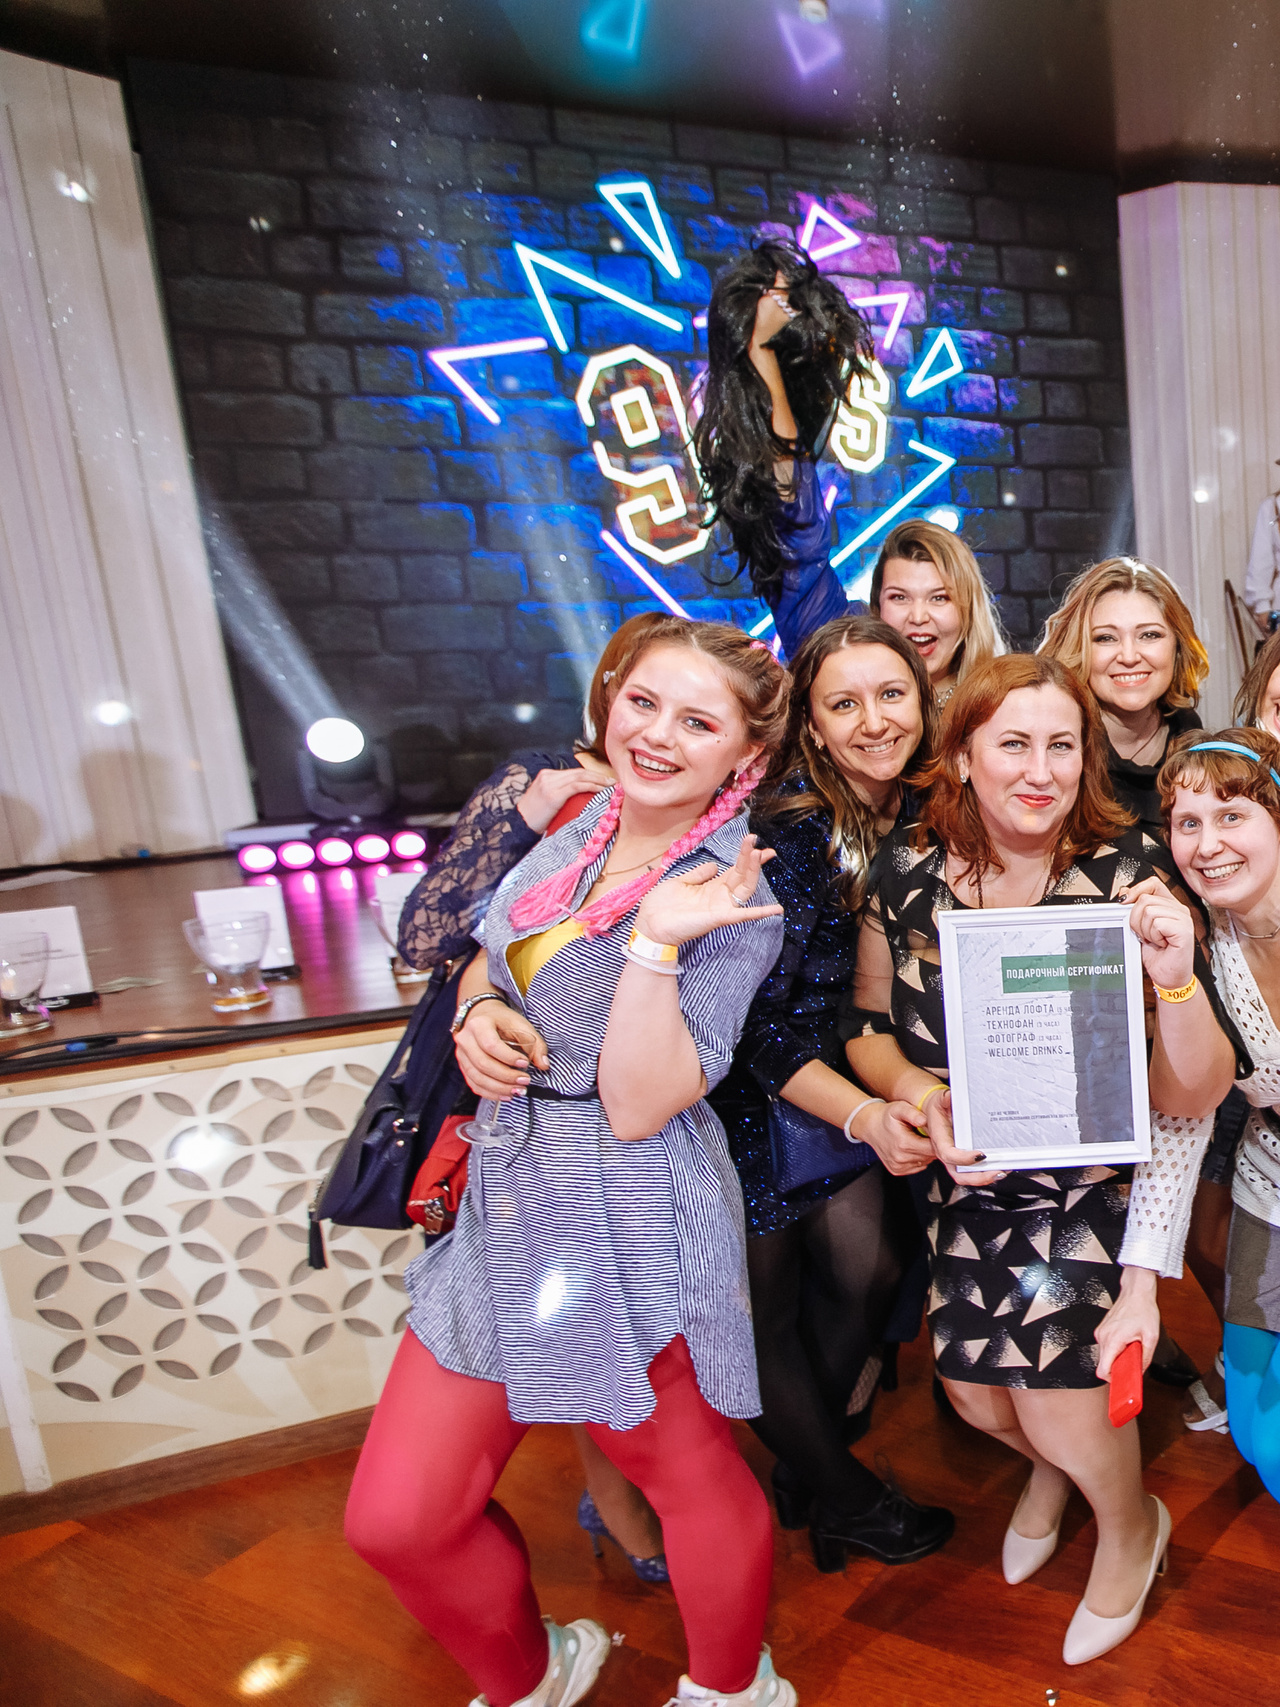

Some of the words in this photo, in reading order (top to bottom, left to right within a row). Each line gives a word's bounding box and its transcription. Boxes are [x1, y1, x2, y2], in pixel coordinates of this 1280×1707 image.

[1006, 965, 1065, 979] ПОДАРОЧНЫЙ
[1067, 964, 1124, 977] СЕРТИФИКАТ
[1024, 1004, 1054, 1014] ЛОФТА
[1032, 1045, 1063, 1056] DRINKS
